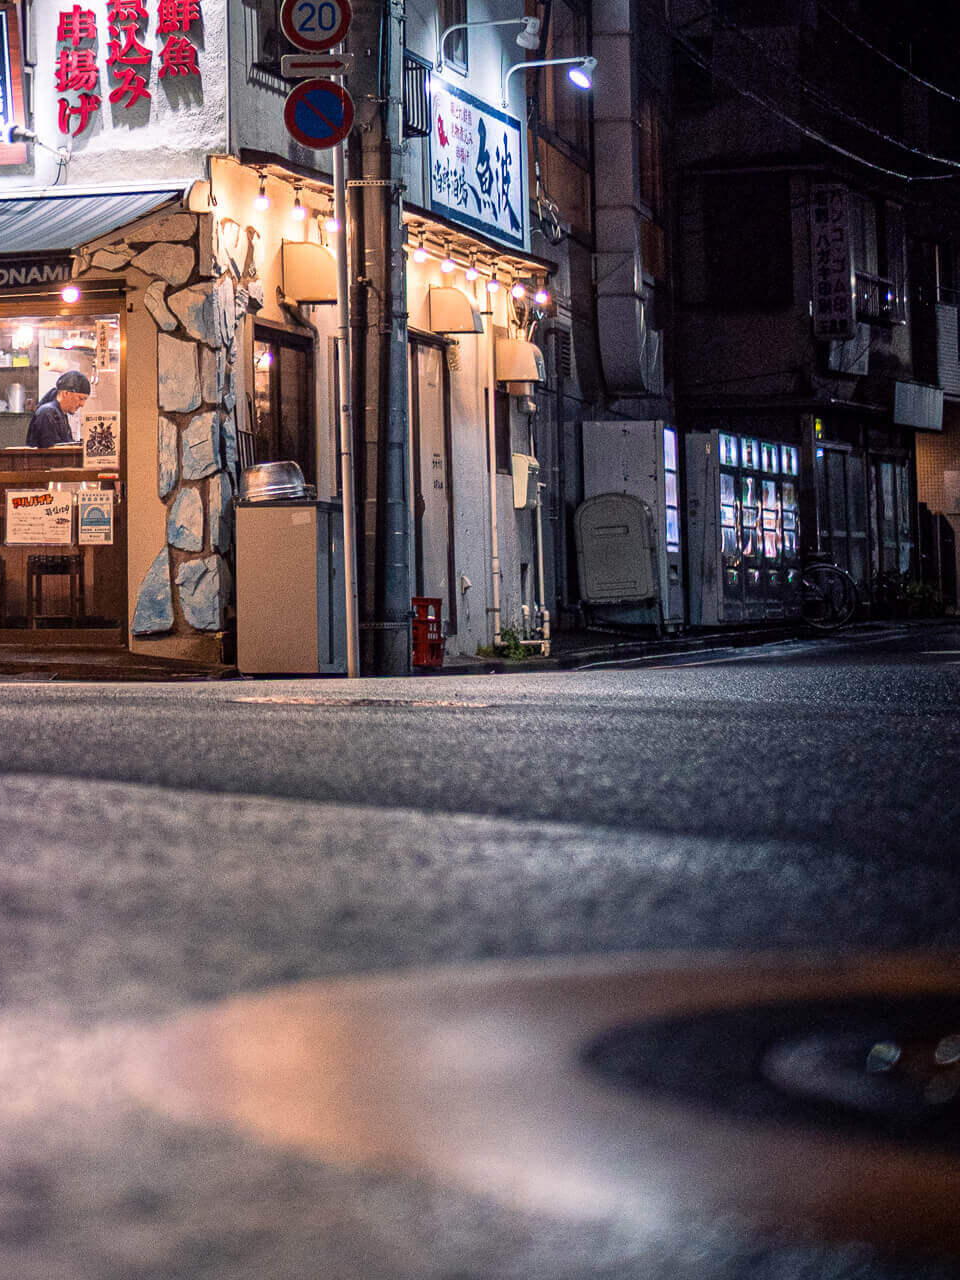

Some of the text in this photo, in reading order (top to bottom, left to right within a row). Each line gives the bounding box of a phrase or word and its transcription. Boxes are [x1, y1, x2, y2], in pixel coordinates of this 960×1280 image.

[297, 2, 336, 33] 20
[55, 4, 101, 137] 串揚げ
